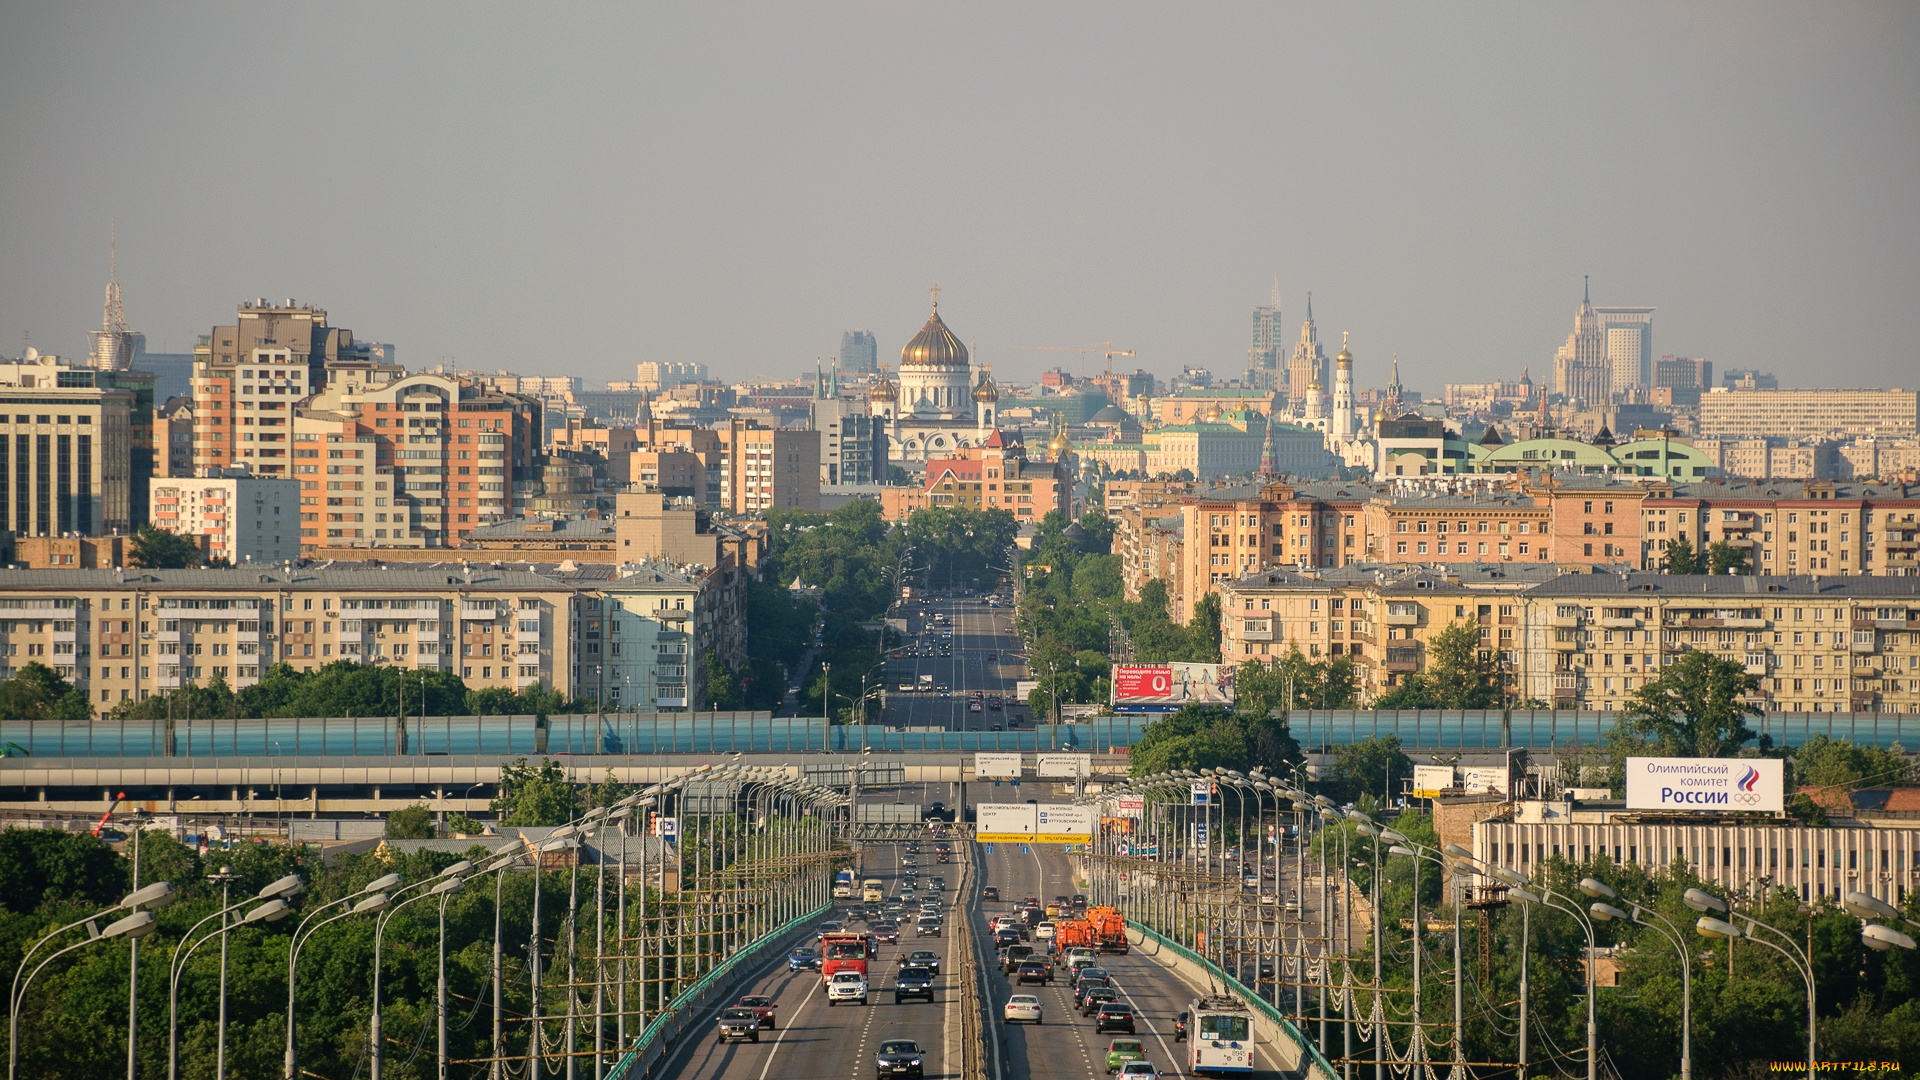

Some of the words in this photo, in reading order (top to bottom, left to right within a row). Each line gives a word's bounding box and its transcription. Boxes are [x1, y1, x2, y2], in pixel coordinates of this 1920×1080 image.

[1647, 762, 1729, 774] Олимпийский
[1680, 777, 1728, 787] комитет
[1661, 787, 1728, 804] России
